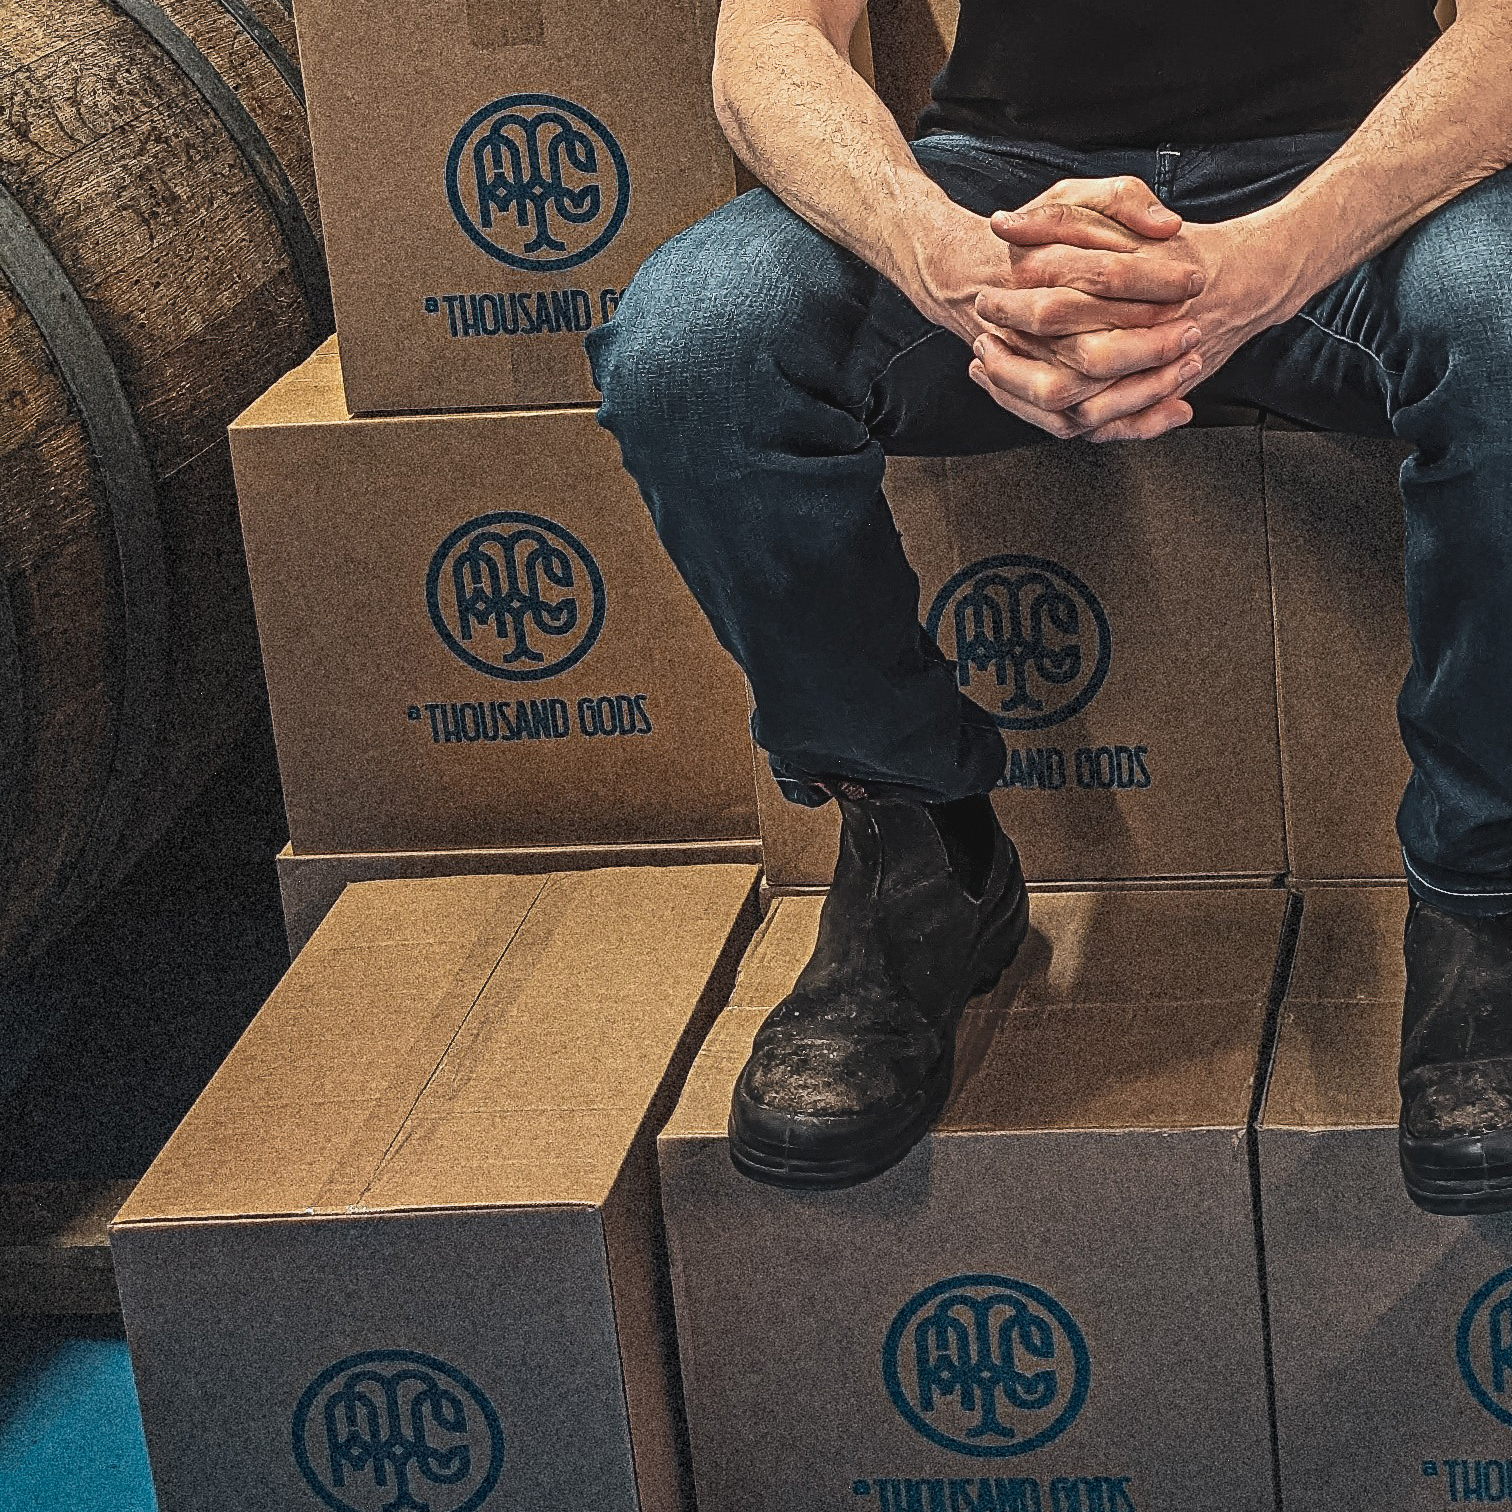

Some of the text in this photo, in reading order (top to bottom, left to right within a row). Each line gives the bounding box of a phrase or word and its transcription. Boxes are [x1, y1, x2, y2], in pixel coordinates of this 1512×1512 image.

[442, 289, 594, 339] THOUSAND
[424, 697, 572, 745] THOUSAND
[575, 692, 654, 738] GODS
[1074, 744, 1152, 790] GODS
